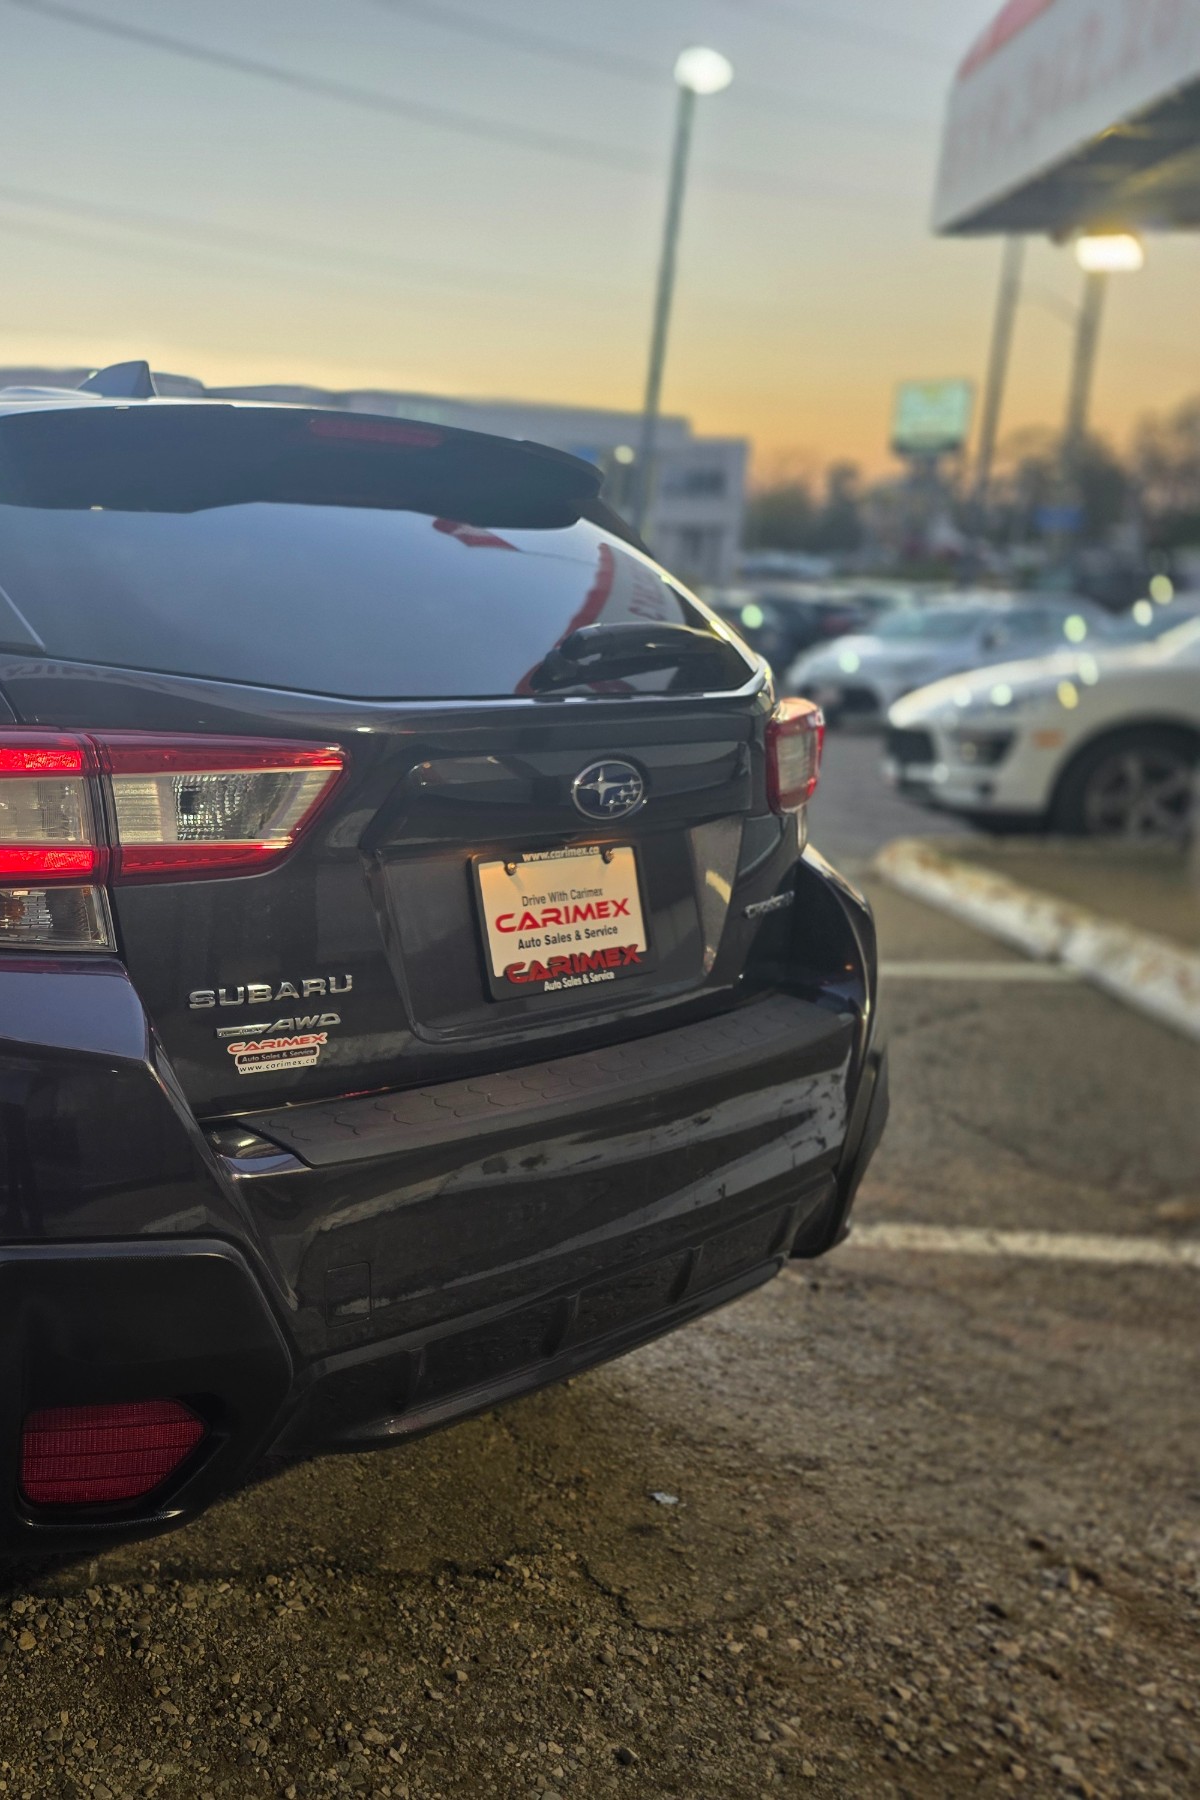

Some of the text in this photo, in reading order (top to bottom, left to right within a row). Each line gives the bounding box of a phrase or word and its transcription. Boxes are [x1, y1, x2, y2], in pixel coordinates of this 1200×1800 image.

[521, 887, 603, 907] Drive With Carimex
[495, 898, 631, 933] CARIMEX
[517, 925, 618, 950] Auto Sales & Service
[504, 943, 641, 983] CARIMEX
[188, 974, 353, 1009] SUBARU
[543, 970, 615, 992] Auto Sales & Service
[264, 1013, 341, 1033] AWD
[229, 1033, 326, 1052] CARIMEX
[241, 1047, 315, 1063] Auto Sales & Service
